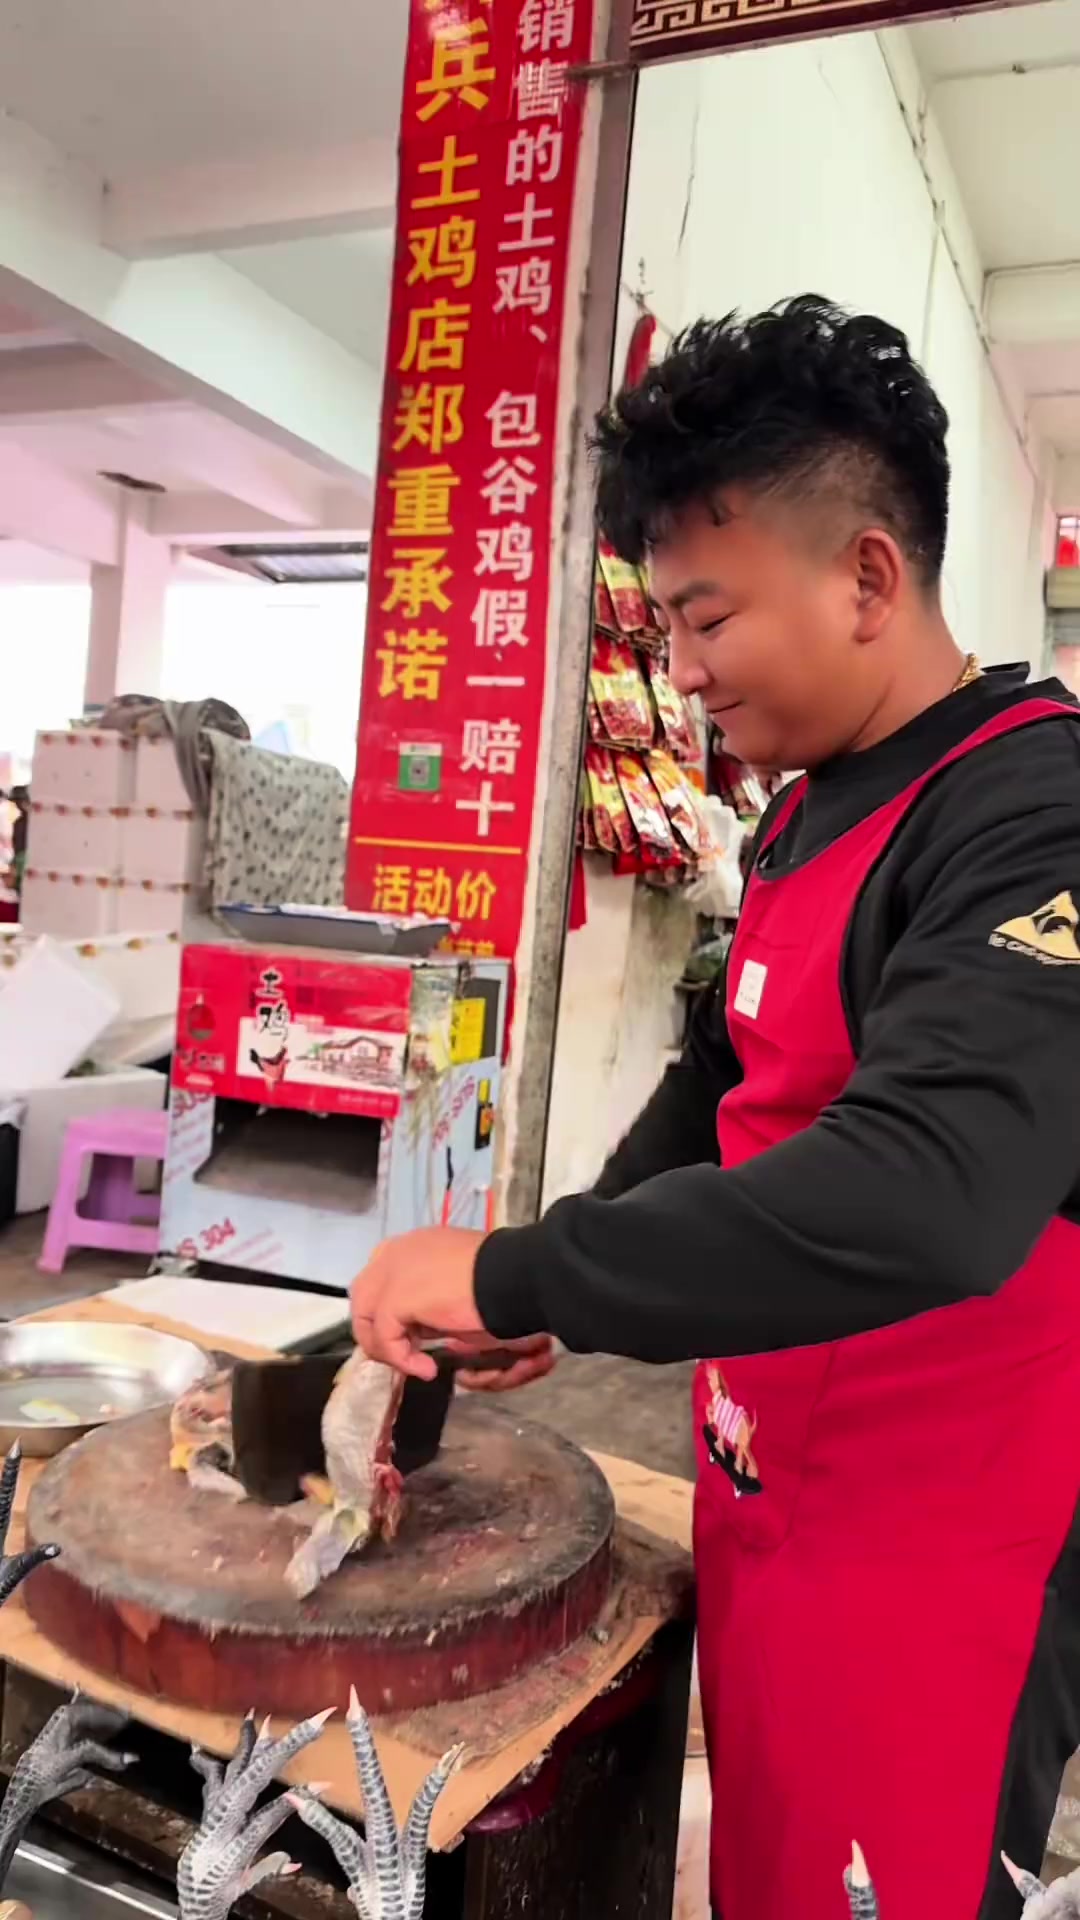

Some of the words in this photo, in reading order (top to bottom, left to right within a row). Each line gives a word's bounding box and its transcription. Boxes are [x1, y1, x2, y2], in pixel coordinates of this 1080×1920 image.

[375, 0, 496, 701] 兵土鸡店郑重承诺
[371, 864, 497, 920] 活动价
[256, 969, 290, 1042] 土鸡
[200, 1217, 235, 1250] 304
